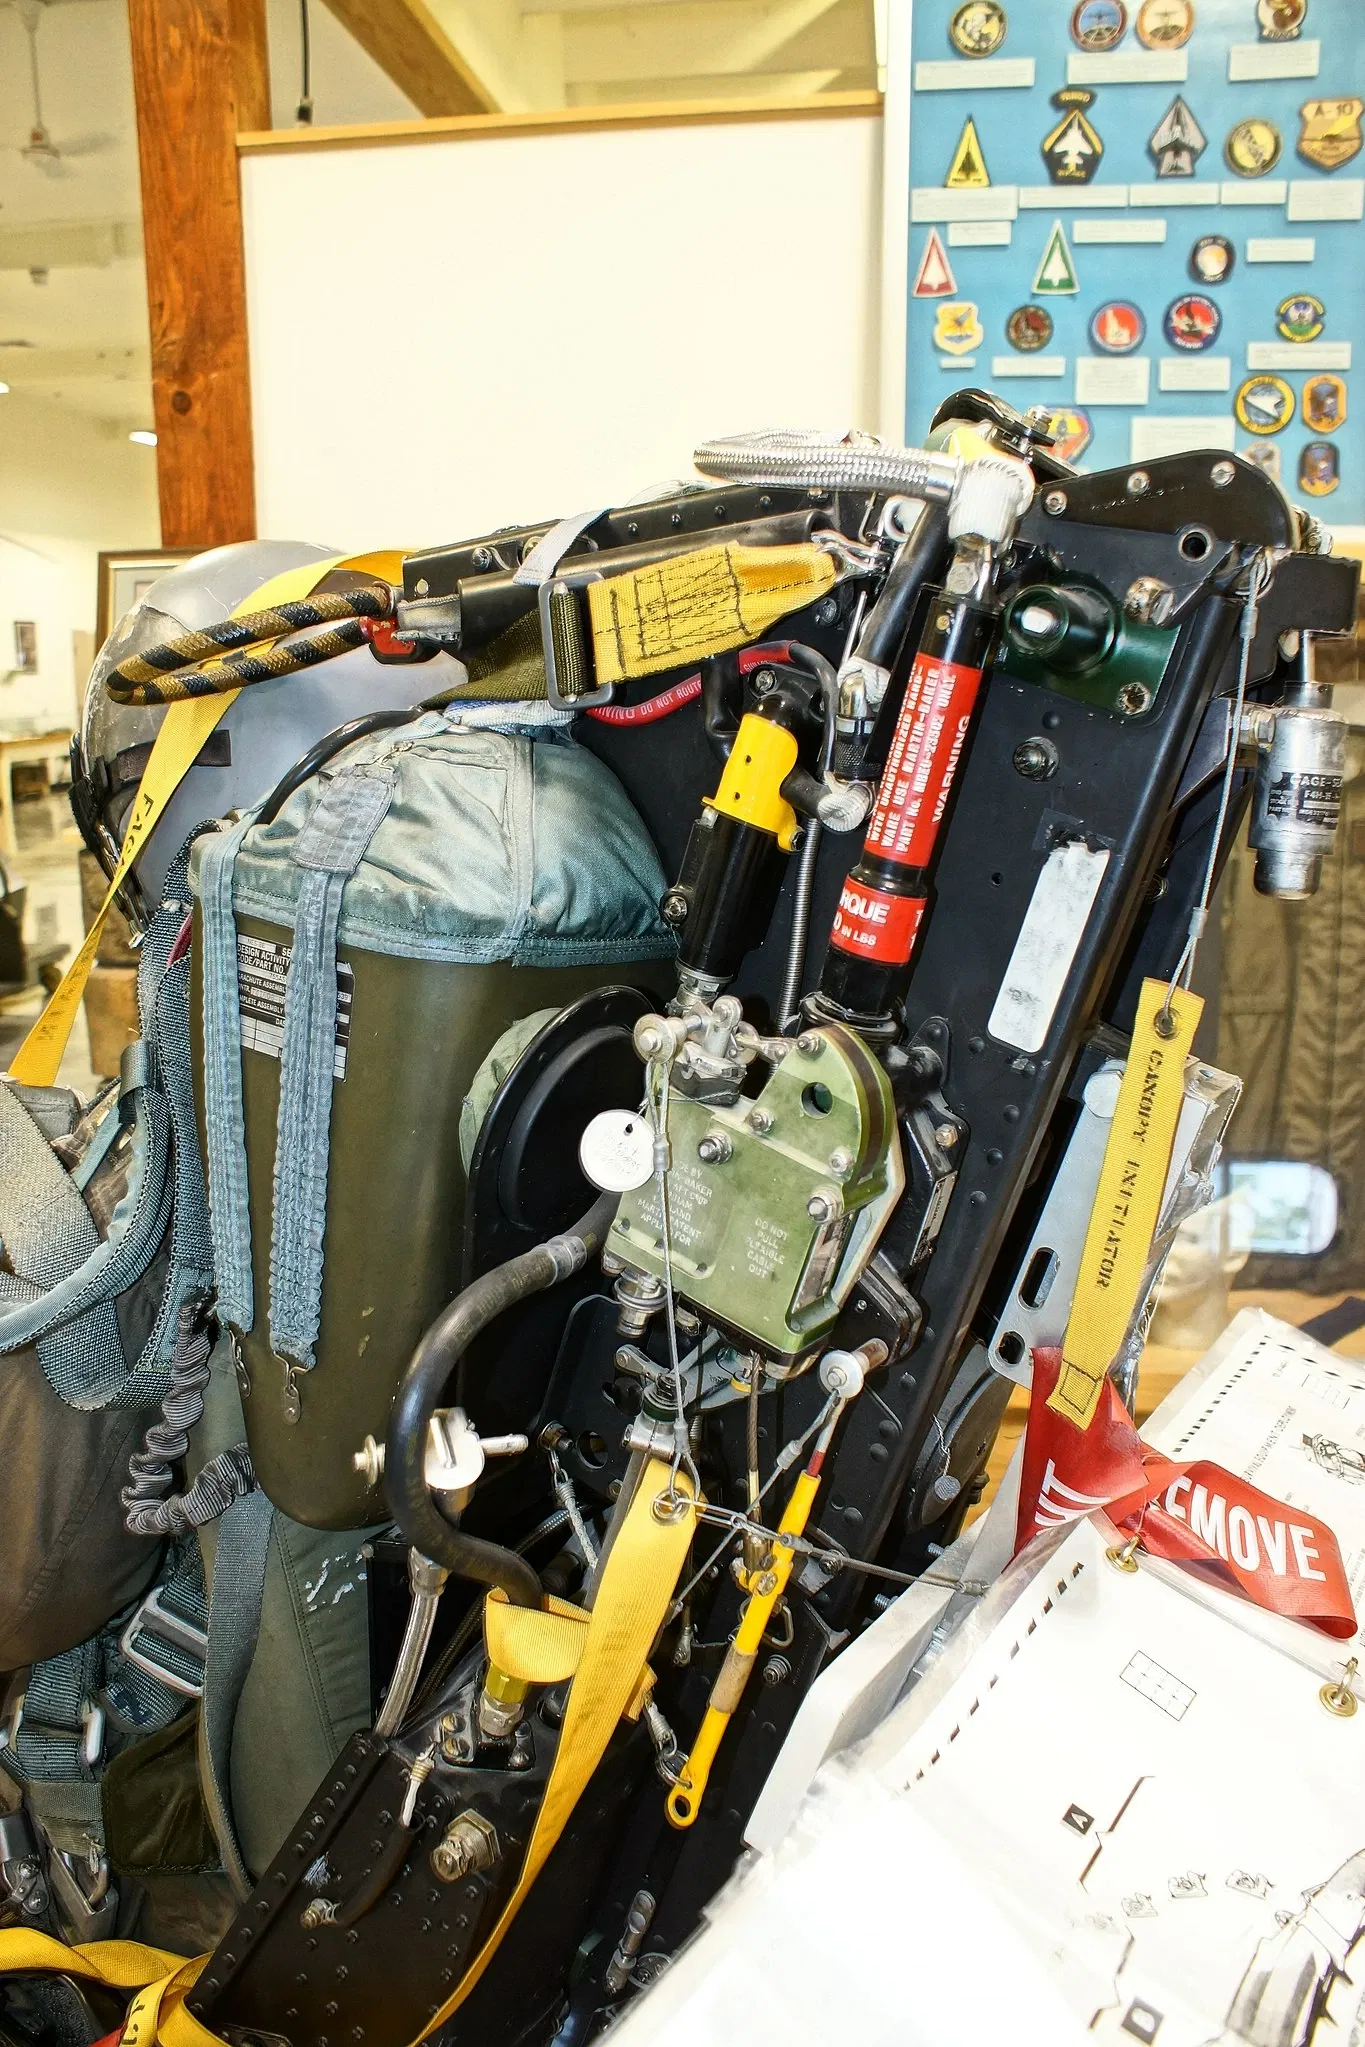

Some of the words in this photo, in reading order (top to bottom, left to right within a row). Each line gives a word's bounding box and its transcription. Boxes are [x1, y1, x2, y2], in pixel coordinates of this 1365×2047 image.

[641, 704, 653, 715] DO
[657, 696, 673, 708] NOT
[880, 811, 901, 848] WARE
[892, 779, 909, 805] USE
[901, 667, 940, 773] MARTIN-BAKER
[869, 811, 886, 842] WITH
[878, 712, 913, 806] UNAUTHORIZED
[932, 715, 969, 824] WARNING
[895, 819, 915, 853] PART
[839, 889, 890, 924] RQUE
[840, 925, 852, 938] IN
[852, 929, 877, 946] LBS
[236, 943, 260, 957] DESIGN
[260, 950, 290, 966] ACTIVITY
[272, 964, 286, 974] NO.
[237, 973, 262, 986] RACHUTE
[262, 980, 287, 993] ASSEMBL
[238, 994, 257, 1006] MPLETE
[256, 1000, 283, 1014] ASSEMBLY
[1133, 1050, 1163, 1146] CANOPY
[636, 1197, 663, 1217] MARTI
[673, 1230, 693, 1246] FOR
[753, 1216, 770, 1230] DO
[768, 1224, 788, 1241] NOT
[755, 1230, 780, 1249] PULL
[747, 1262, 767, 1279] OUT
[1164, 1476, 1327, 1582] EMOVE
